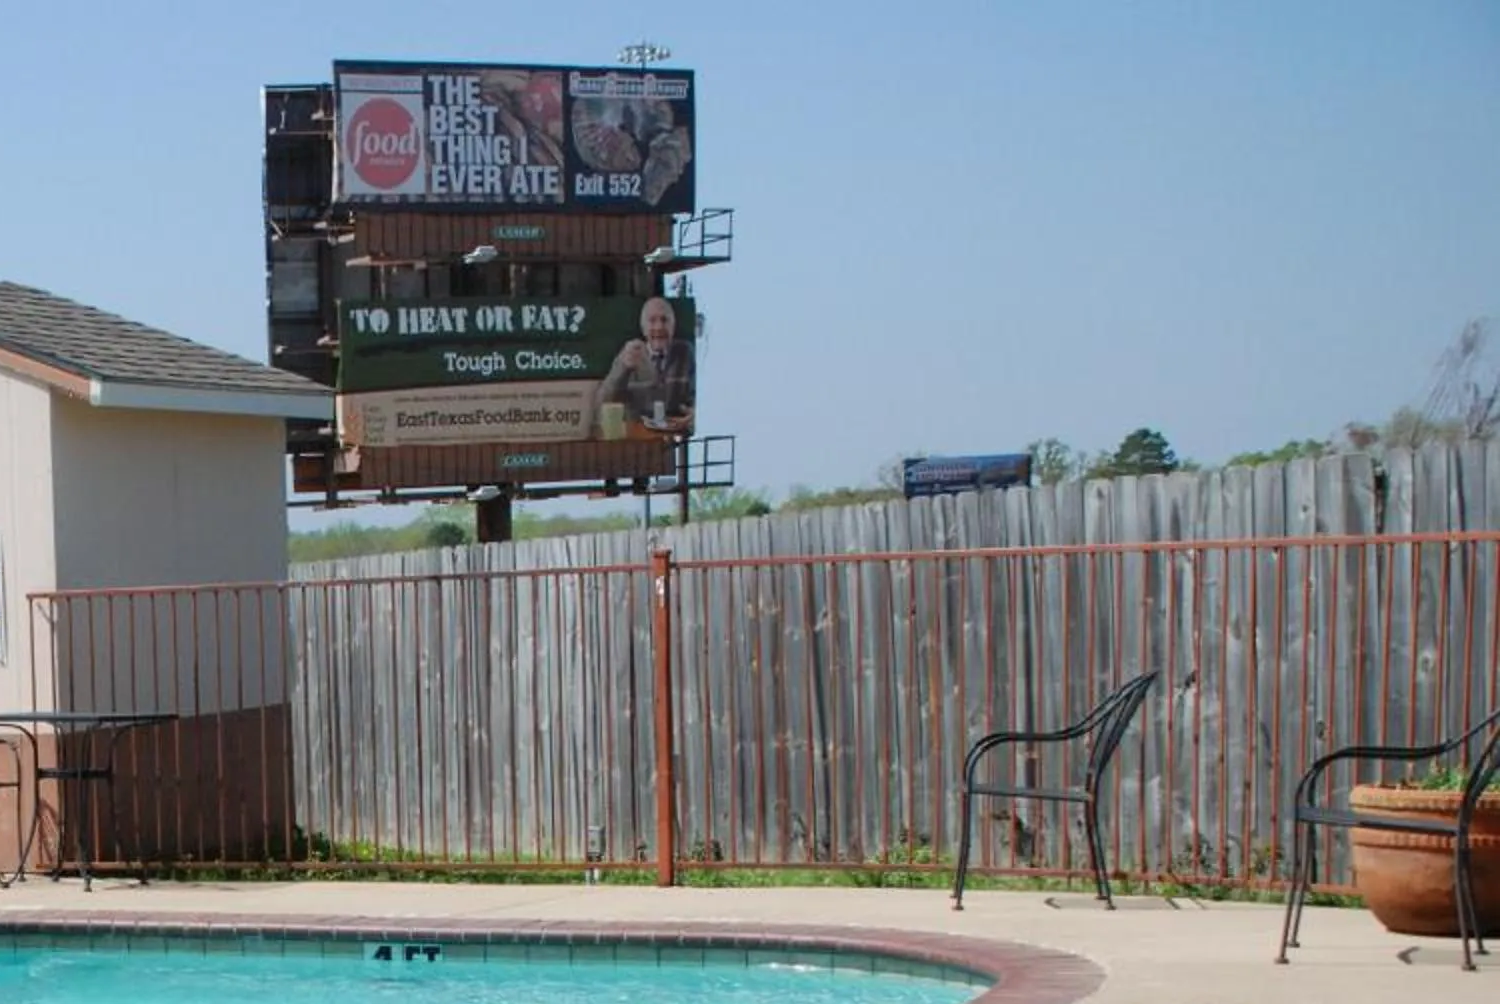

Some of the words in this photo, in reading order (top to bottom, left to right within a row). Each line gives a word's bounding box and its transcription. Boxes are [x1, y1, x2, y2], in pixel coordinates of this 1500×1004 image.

[427, 75, 481, 104] THE
[429, 104, 499, 135] BEST
[353, 118, 417, 167] food
[430, 135, 511, 165] THING
[520, 136, 528, 165] I
[431, 165, 502, 195] EVER
[509, 165, 560, 195] ATE
[574, 173, 604, 196] Exit
[609, 174, 641, 197] 552
[350, 307, 391, 334] TO
[398, 307, 469, 335] HEAT
[475, 305, 514, 333] OR
[443, 351, 507, 376] Tough
[515, 350, 588, 371] Choice.
[373, 945, 394, 962] 4
[404, 945, 442, 962] FT
